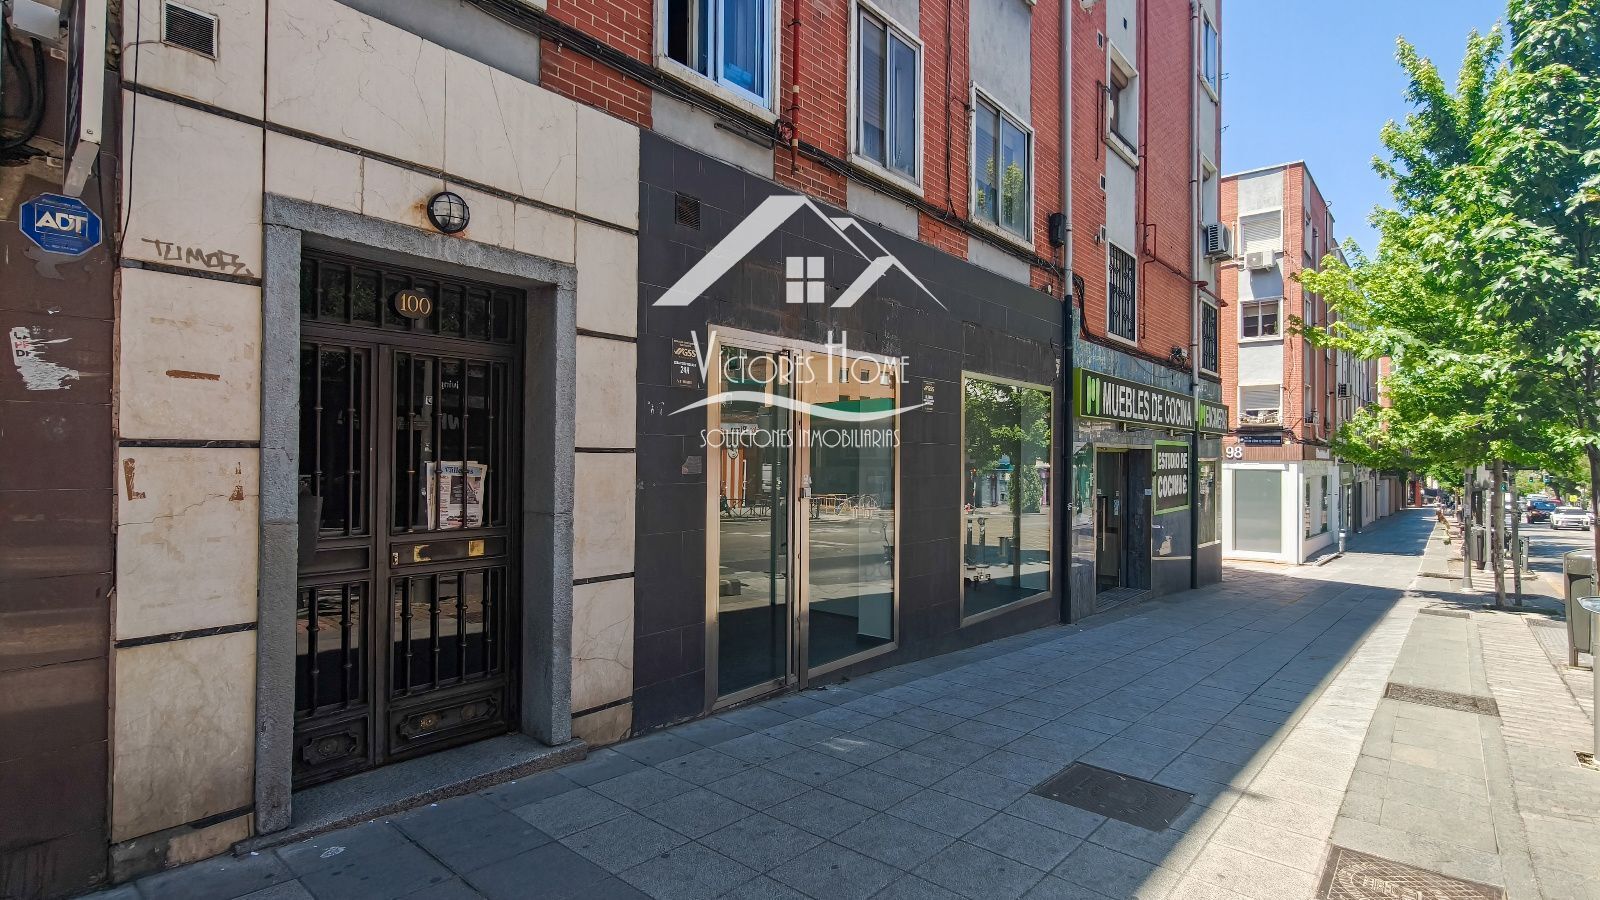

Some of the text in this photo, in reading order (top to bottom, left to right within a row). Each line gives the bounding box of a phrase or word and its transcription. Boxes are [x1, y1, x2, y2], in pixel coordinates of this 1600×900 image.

[36, 211, 88, 234] ADT
[400, 293, 431, 315] 100
[1102, 381, 1149, 422] MUEBLES
[1151, 392, 1163, 423] DE
[1164, 395, 1192, 428] COCINA
[1180, 452, 1188, 469] DE
[1225, 446, 1243, 459] 98
